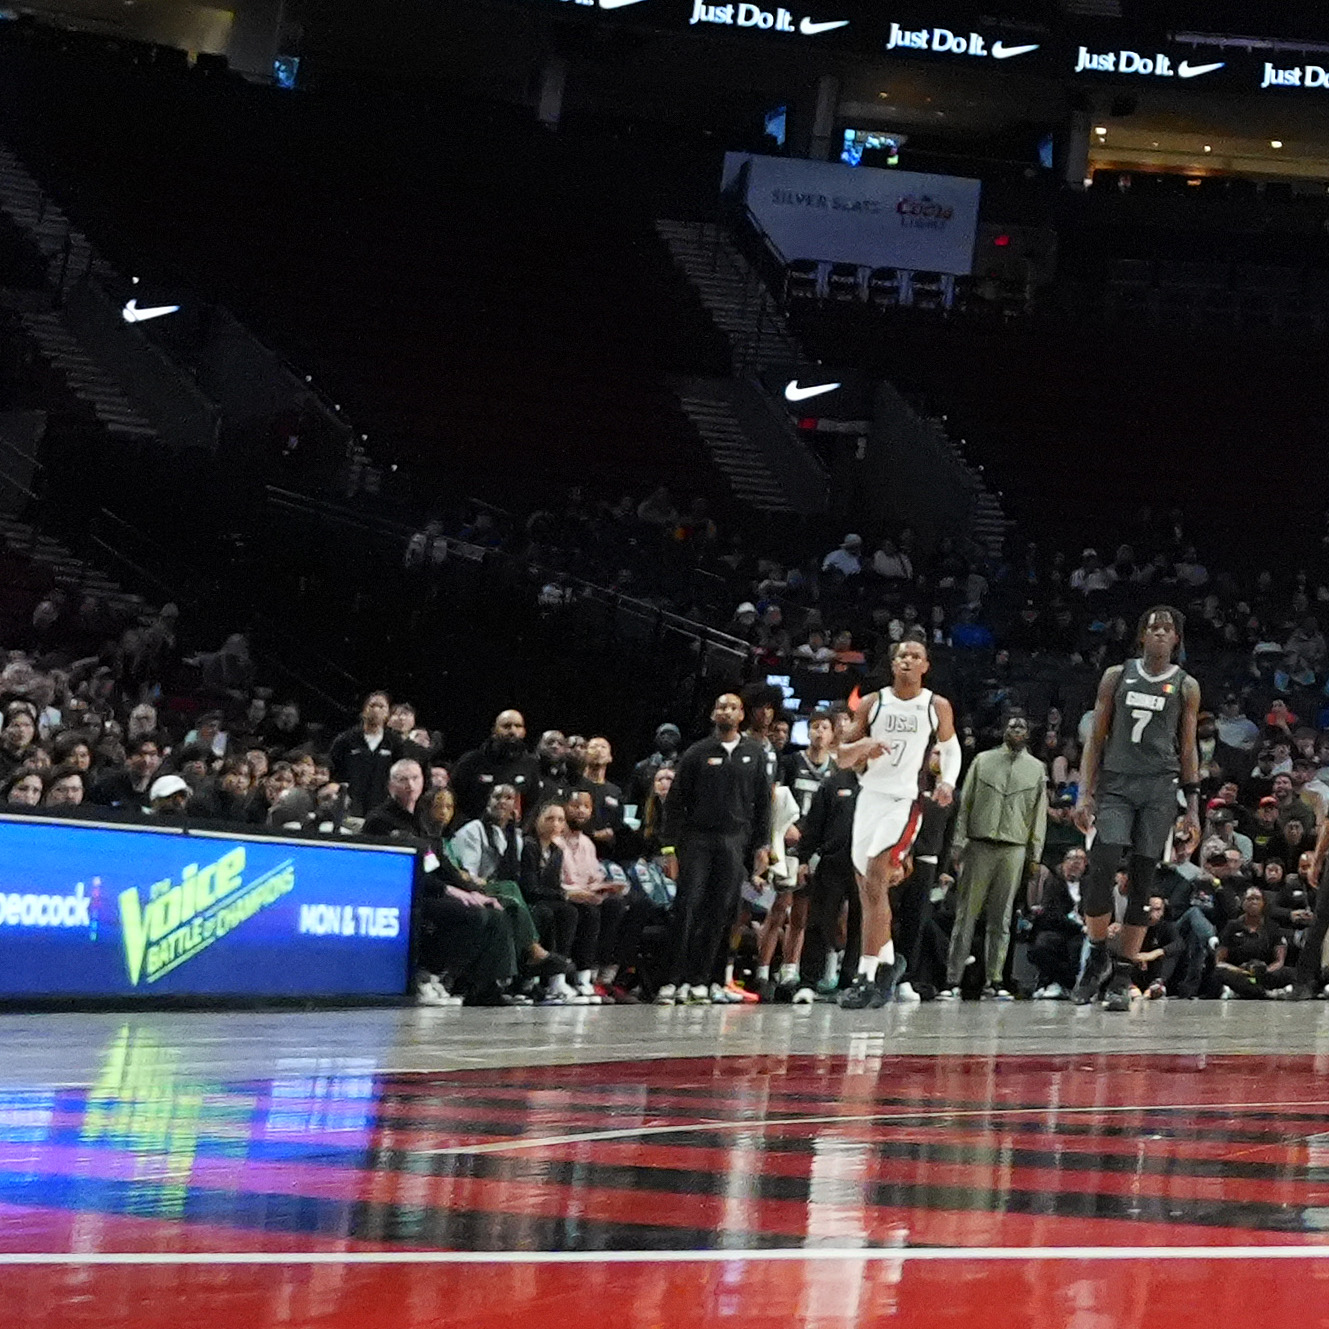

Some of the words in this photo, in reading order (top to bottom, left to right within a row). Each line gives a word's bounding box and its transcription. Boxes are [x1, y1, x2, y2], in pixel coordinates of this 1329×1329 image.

[736, 3, 774, 29] Do
[774, 7, 795, 32] It.
[886, 22, 930, 50] Just
[931, 28, 968, 54] Do
[968, 32, 988, 56] It.
[1074, 46, 1117, 73] Just
[1118, 50, 1154, 75] Do
[1154, 53, 1174, 76] It.
[1260, 62, 1303, 88] Just
[884, 714, 919, 733] USA
[1130, 708, 1153, 744] 7
[890, 738, 908, 768] 7
[300, 904, 337, 937] MON
[341, 907, 355, 937] &
[357, 905, 400, 938] TUES
[146, 918, 204, 974] BATTLE
